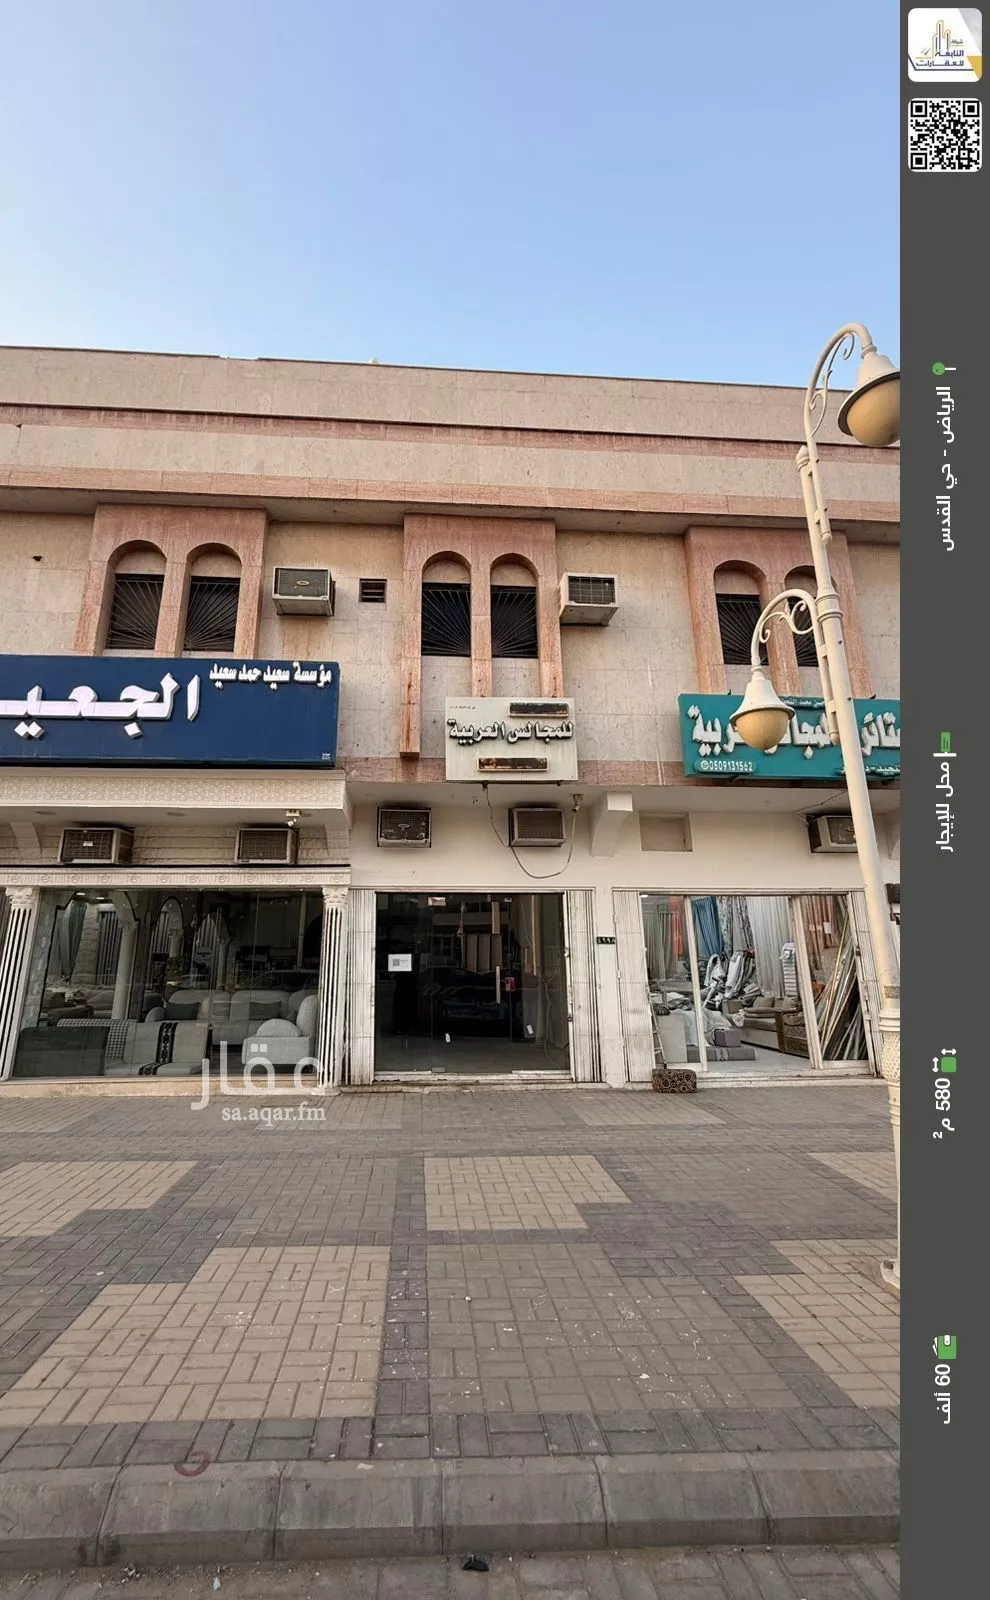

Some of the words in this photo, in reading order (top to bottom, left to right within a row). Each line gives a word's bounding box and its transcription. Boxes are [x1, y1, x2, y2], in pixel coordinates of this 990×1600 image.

[208, 662, 237, 689] سعيد
[262, 664, 290, 691] سعيد
[292, 660, 333, 688] مؤسسة
[0, 672, 200, 739] الجعي
[446, 717, 507, 746] العربية
[506, 720, 575, 744] للمجالس
[709, 760, 754, 772] 0509131562
